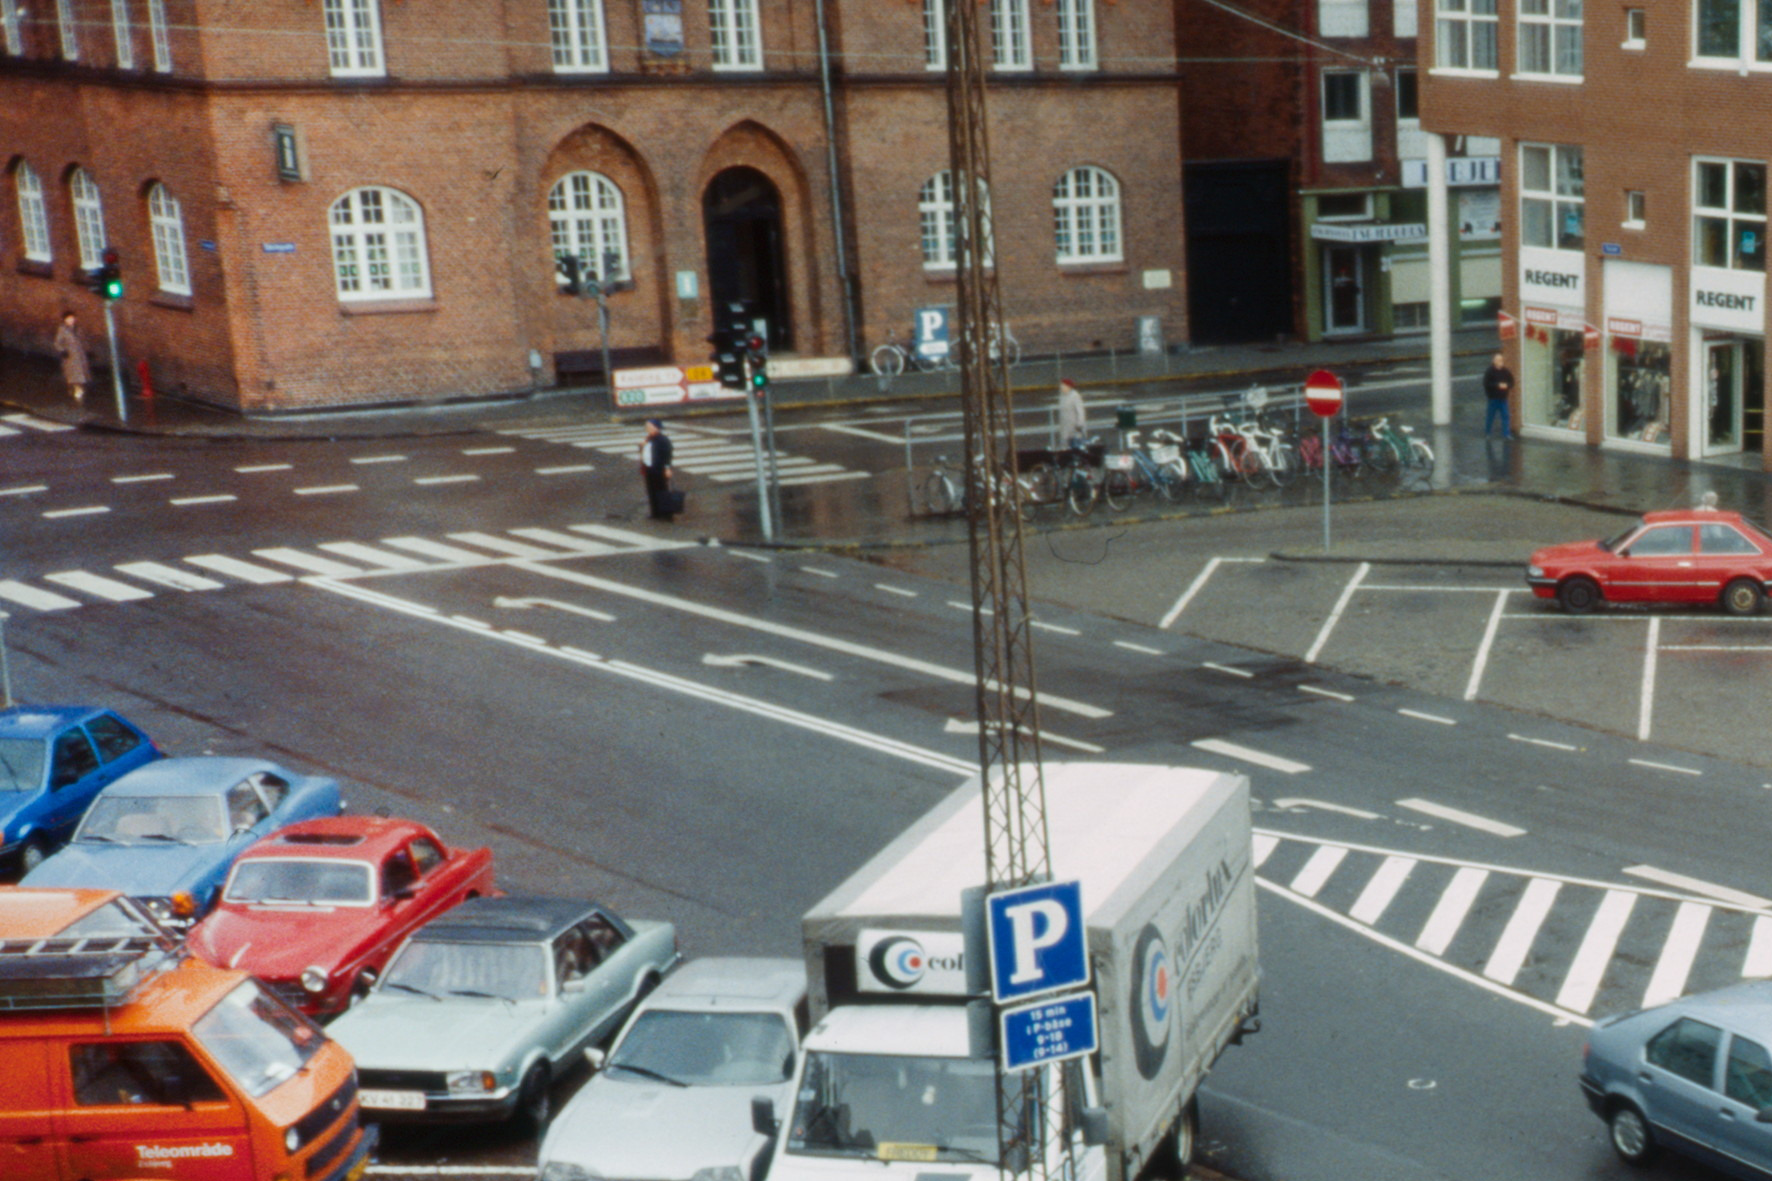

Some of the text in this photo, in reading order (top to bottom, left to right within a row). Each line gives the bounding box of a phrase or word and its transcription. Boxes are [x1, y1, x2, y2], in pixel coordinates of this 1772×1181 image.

[1525, 269, 1579, 289] REGENT
[1696, 290, 1756, 311] REGENT
[920, 310, 943, 340] P
[1004, 899, 1069, 985] P
[927, 953, 964, 971] col
[1030, 1005, 1066, 1021] 15 min
[135, 1142, 233, 1158] Teleområde
